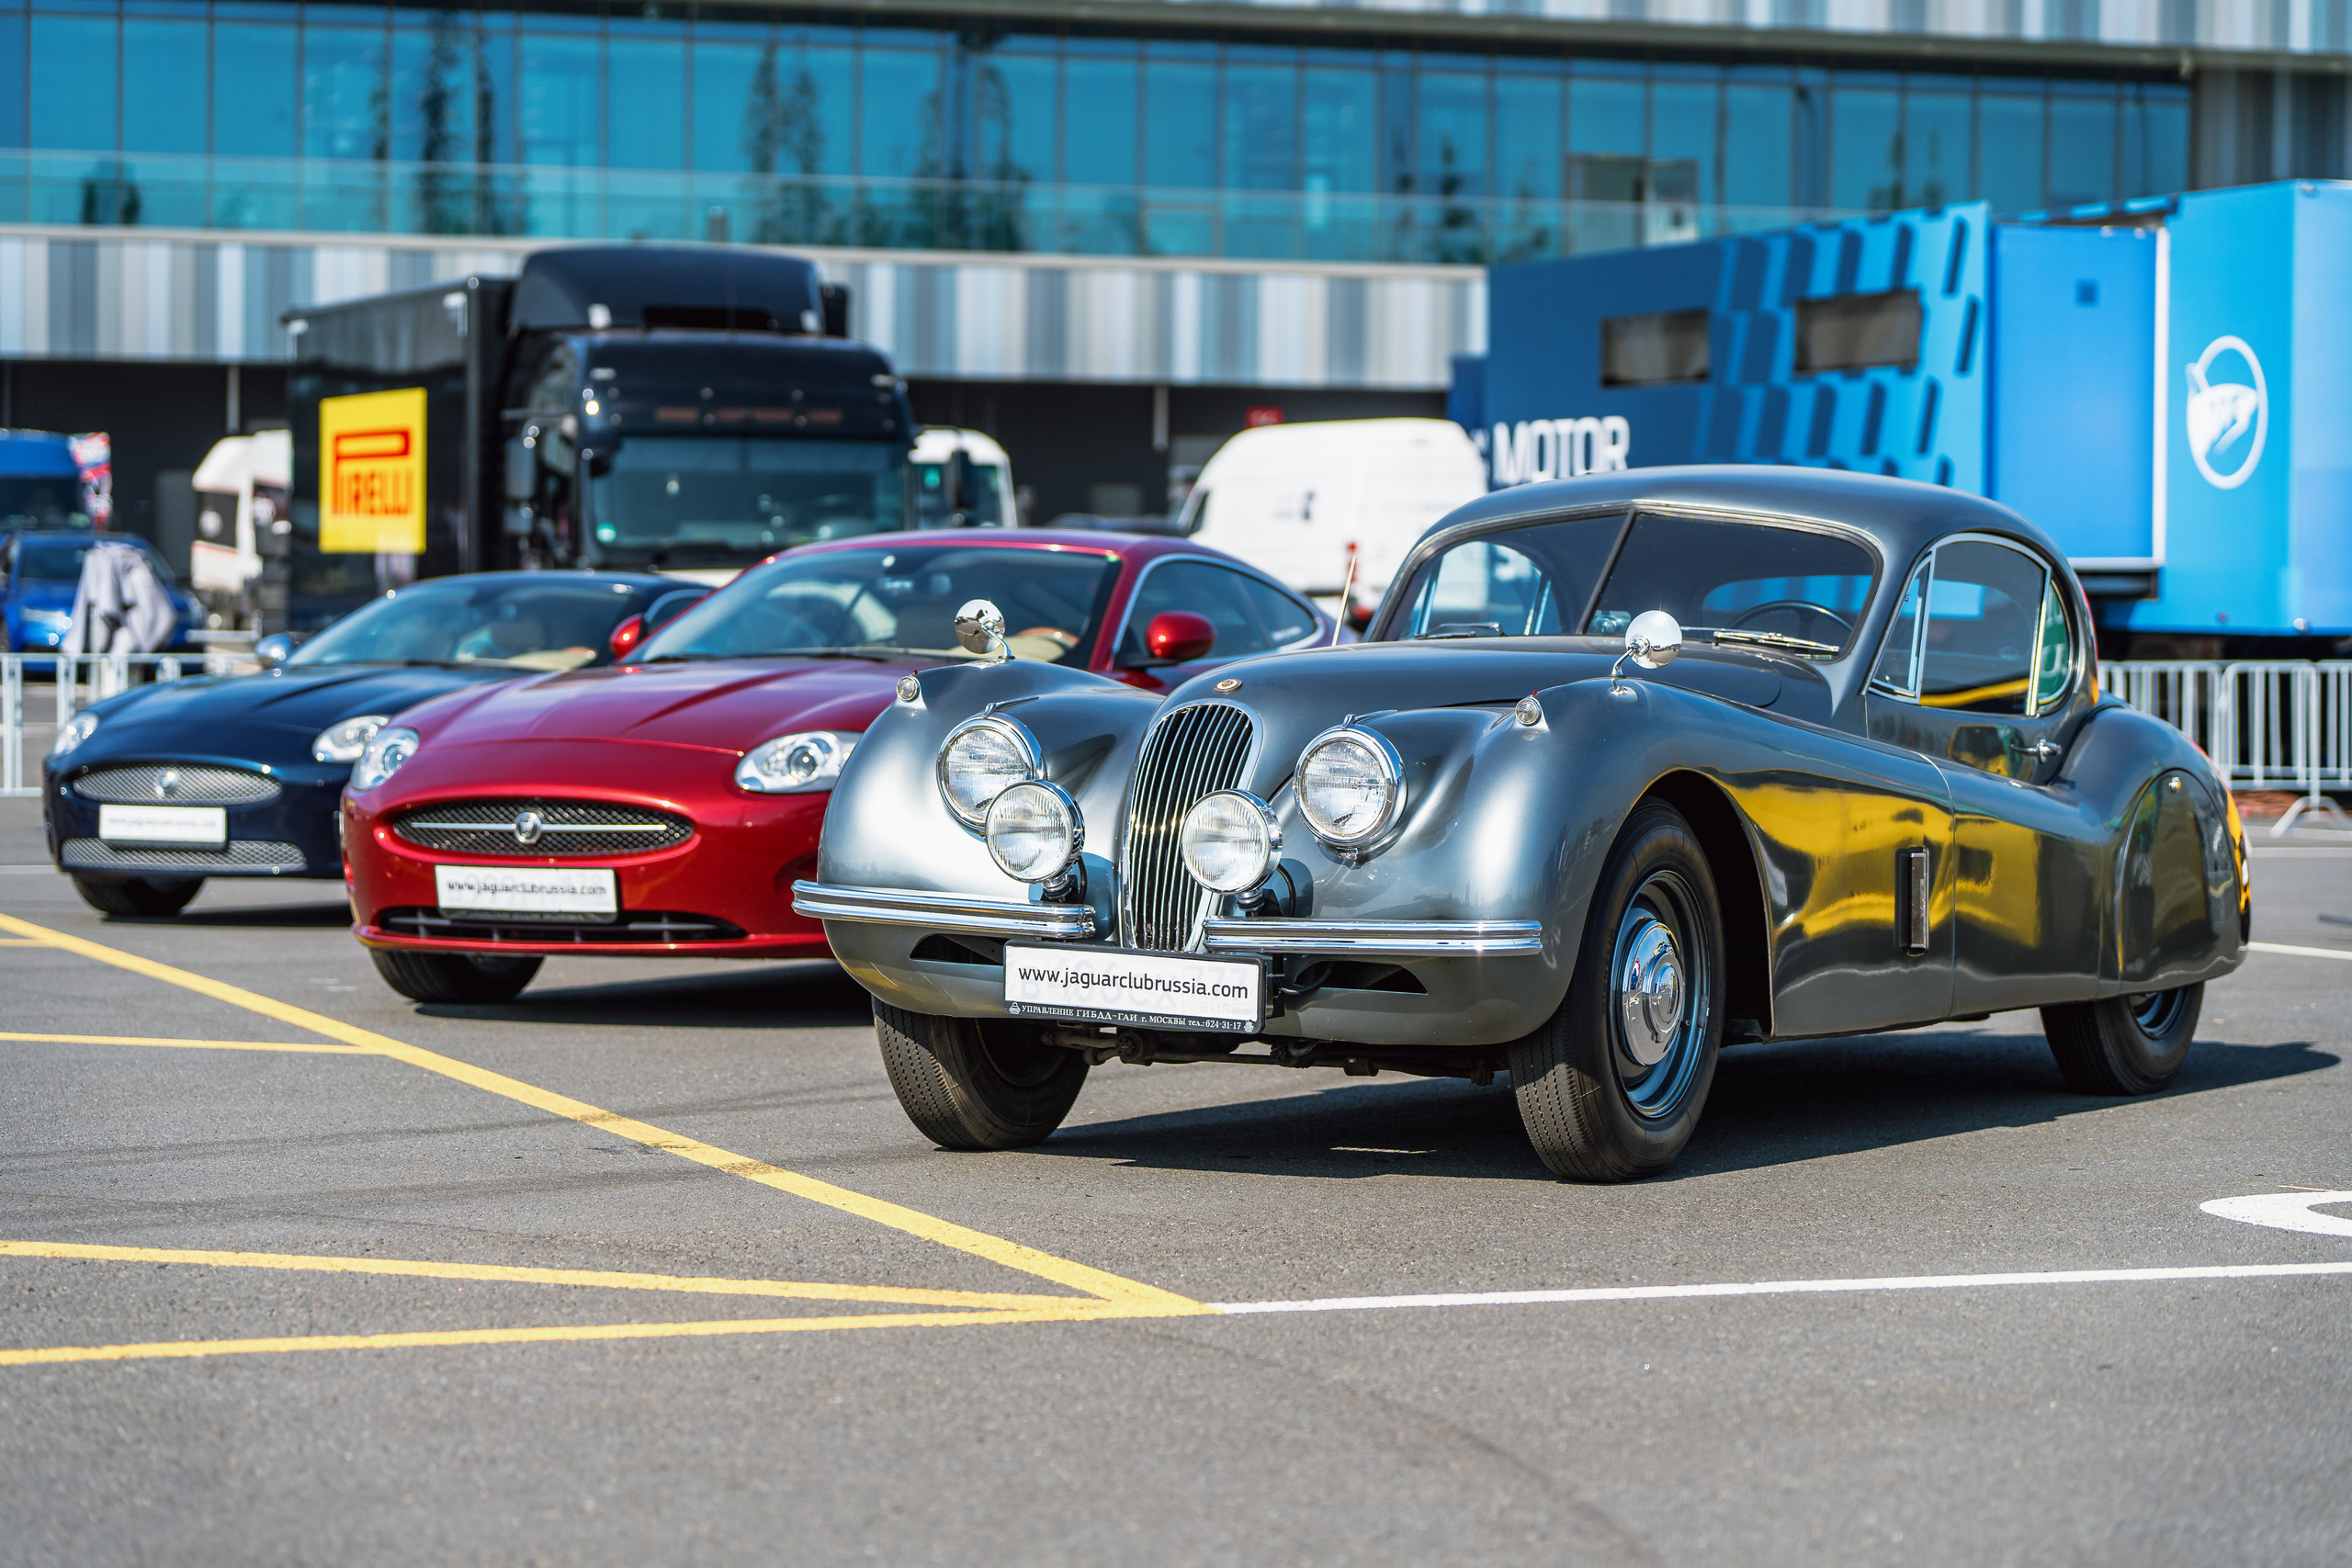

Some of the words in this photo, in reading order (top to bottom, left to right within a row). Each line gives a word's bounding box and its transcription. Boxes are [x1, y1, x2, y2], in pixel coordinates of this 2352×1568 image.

[332, 428, 413, 518] PIRELLI
[1493, 415, 1630, 485] MOTOR
[1018, 967, 1248, 998] www.jaguarclubrussia.com
[1022, 1005, 1074, 1017] УПРАВЛЕНИЕ
[1076, 1010, 1138, 1021] ГИБДД-ГАИ
[1149, 1015, 1187, 1025] МОСКВЫ
